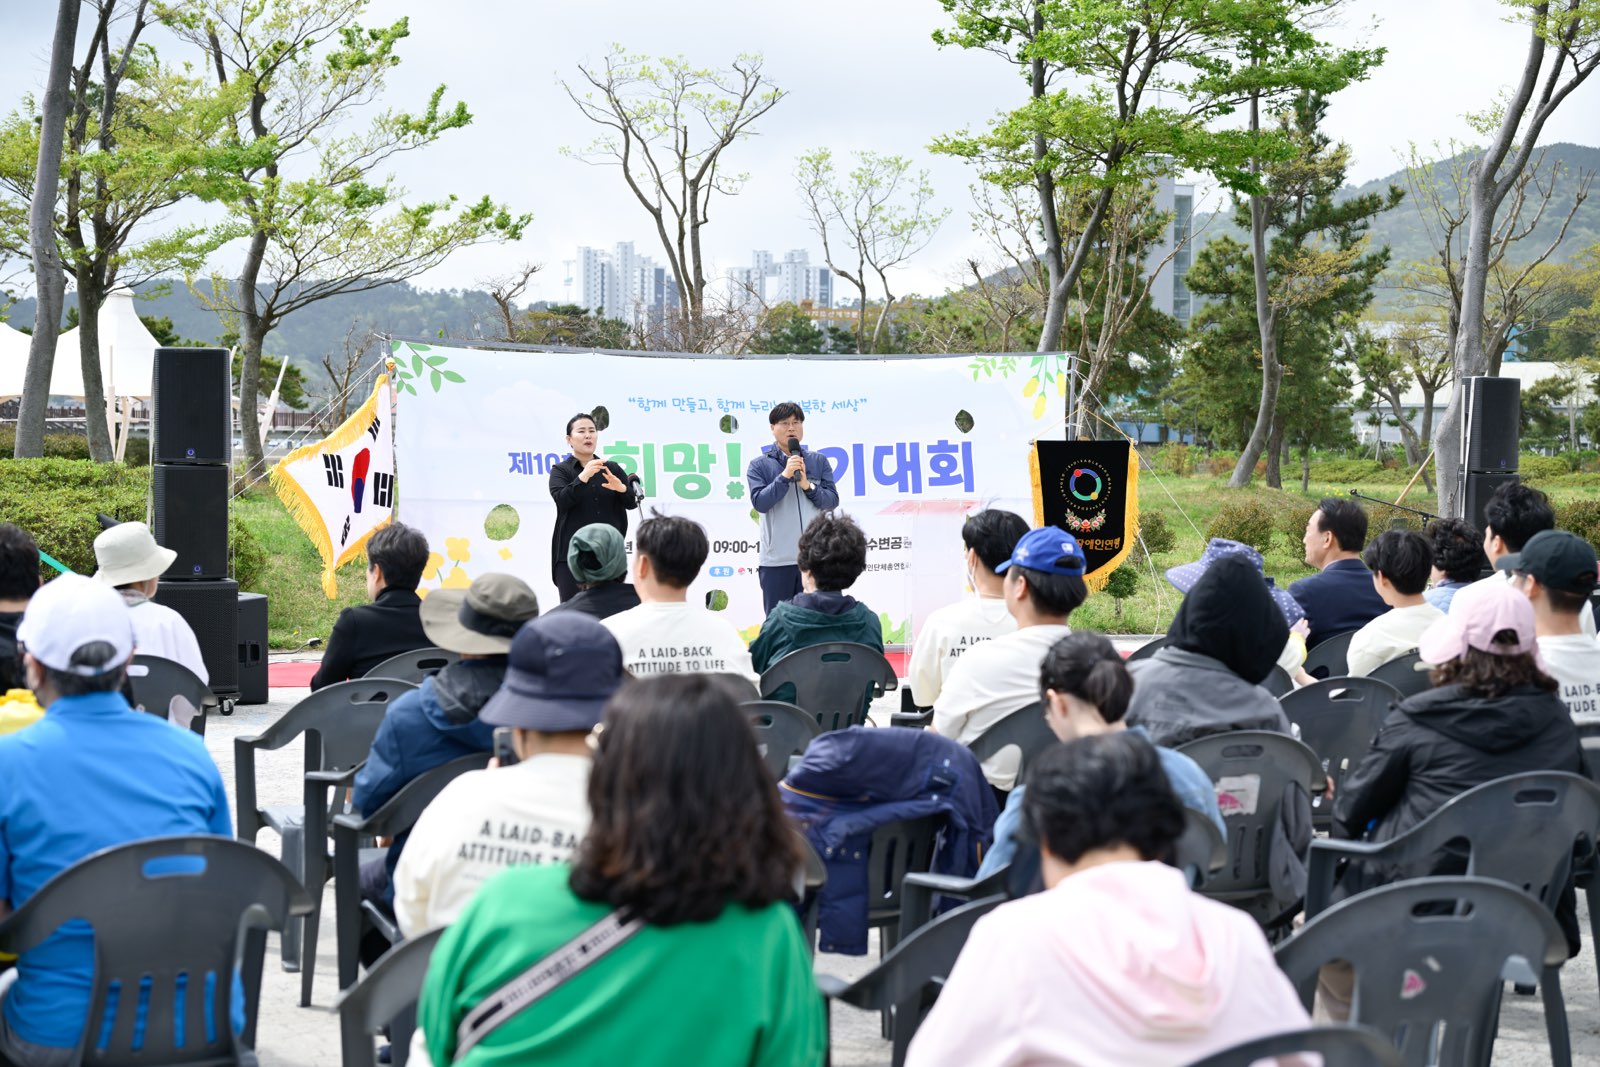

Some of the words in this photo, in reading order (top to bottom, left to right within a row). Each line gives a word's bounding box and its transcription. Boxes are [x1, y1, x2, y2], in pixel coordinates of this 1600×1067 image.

[672, 397, 713, 413] 만들고,
[717, 399, 745, 413] 함께
[749, 399, 777, 413] 누리
[788, 399, 826, 414] 복한
[761, 440, 975, 497] 기대회
[713, 540, 760, 553] 09:00~1
[960, 635, 967, 645] A
[639, 648, 646, 659] A
[651, 646, 713, 658] LAID-BACK
[627, 661, 681, 674] ATTITUDE
[686, 660, 700, 671] TO
[705, 660, 725, 671] LIFE
[480, 820, 491, 836] A
[499, 822, 578, 850] LAID-BA
